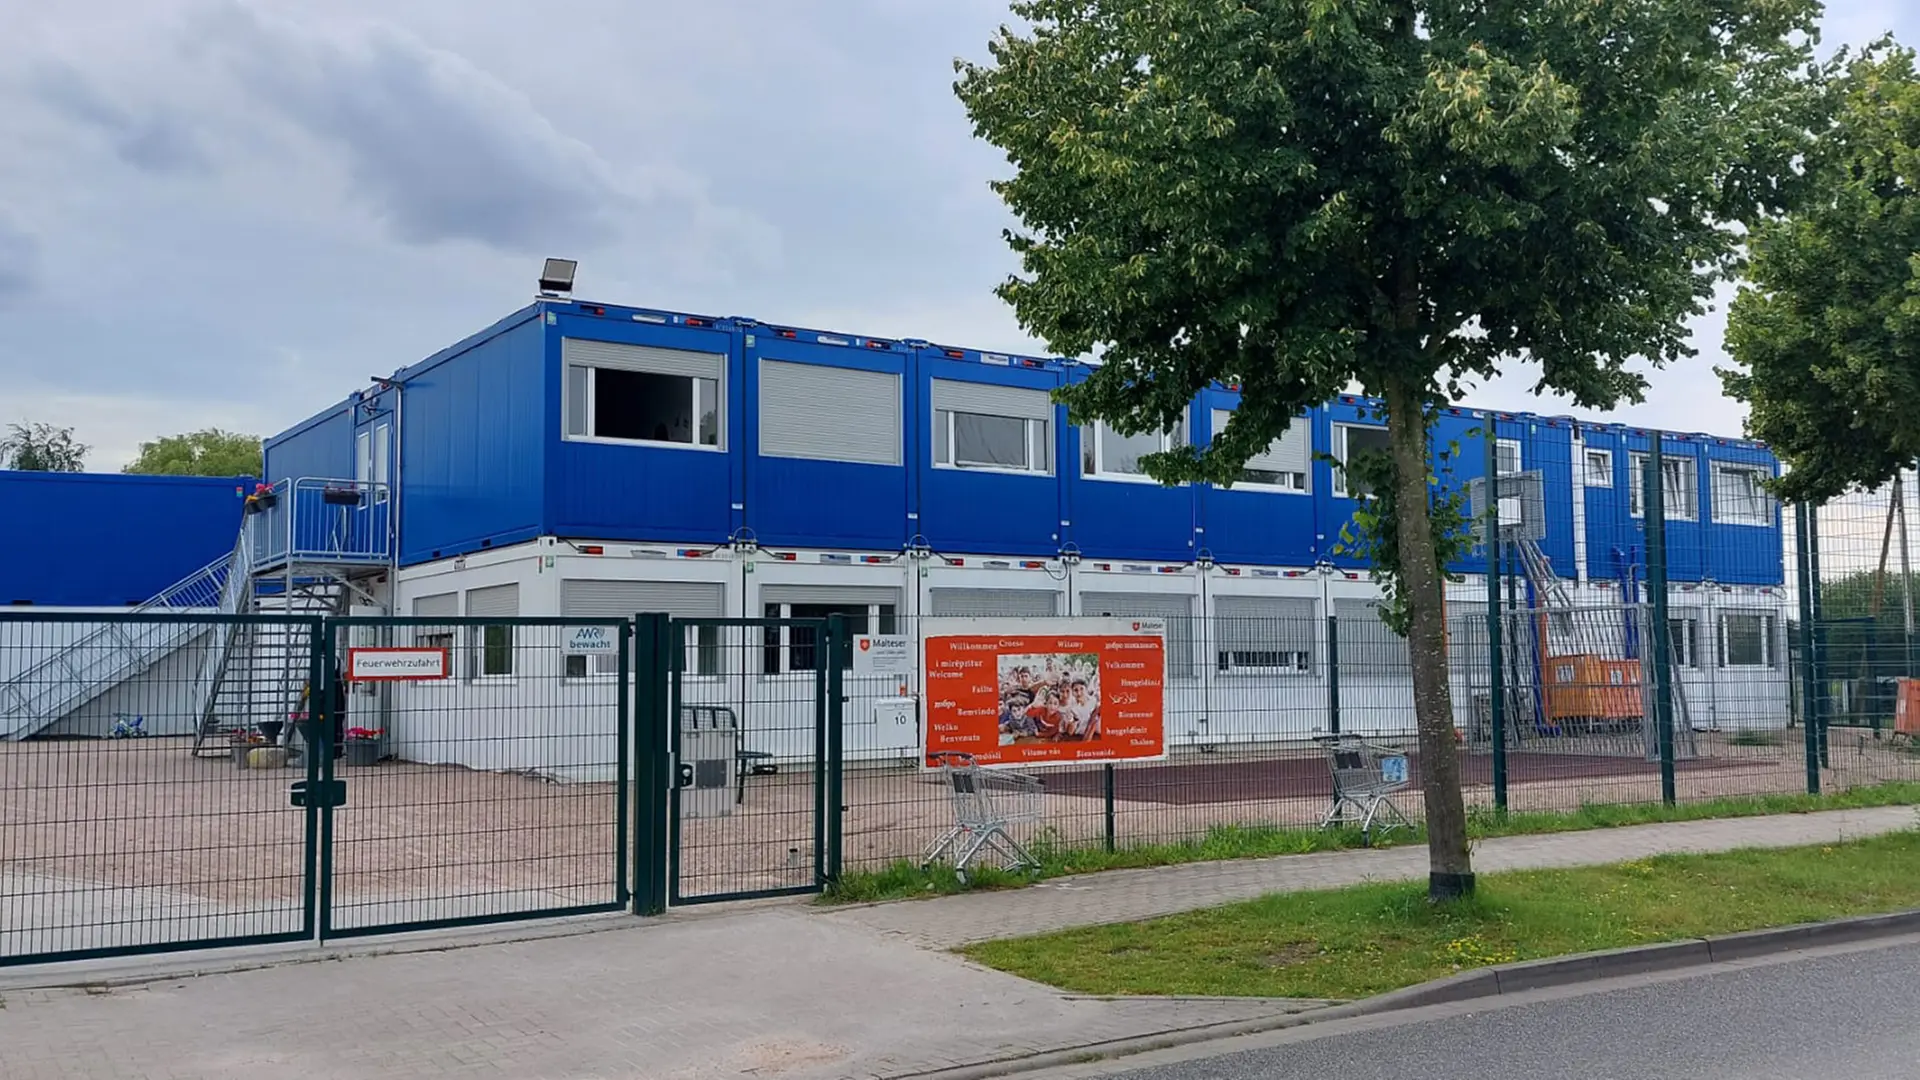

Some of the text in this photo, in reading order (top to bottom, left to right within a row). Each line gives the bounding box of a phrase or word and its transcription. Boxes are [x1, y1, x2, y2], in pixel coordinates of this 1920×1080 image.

[569, 640, 611, 649] bewacht
[872, 638, 906, 648] Malteser
[949, 641, 998, 651] Willkommen
[357, 658, 441, 668] Feuerwehrzufahrt
[929, 670, 964, 678] Welcome
[895, 715, 906, 724] 10
